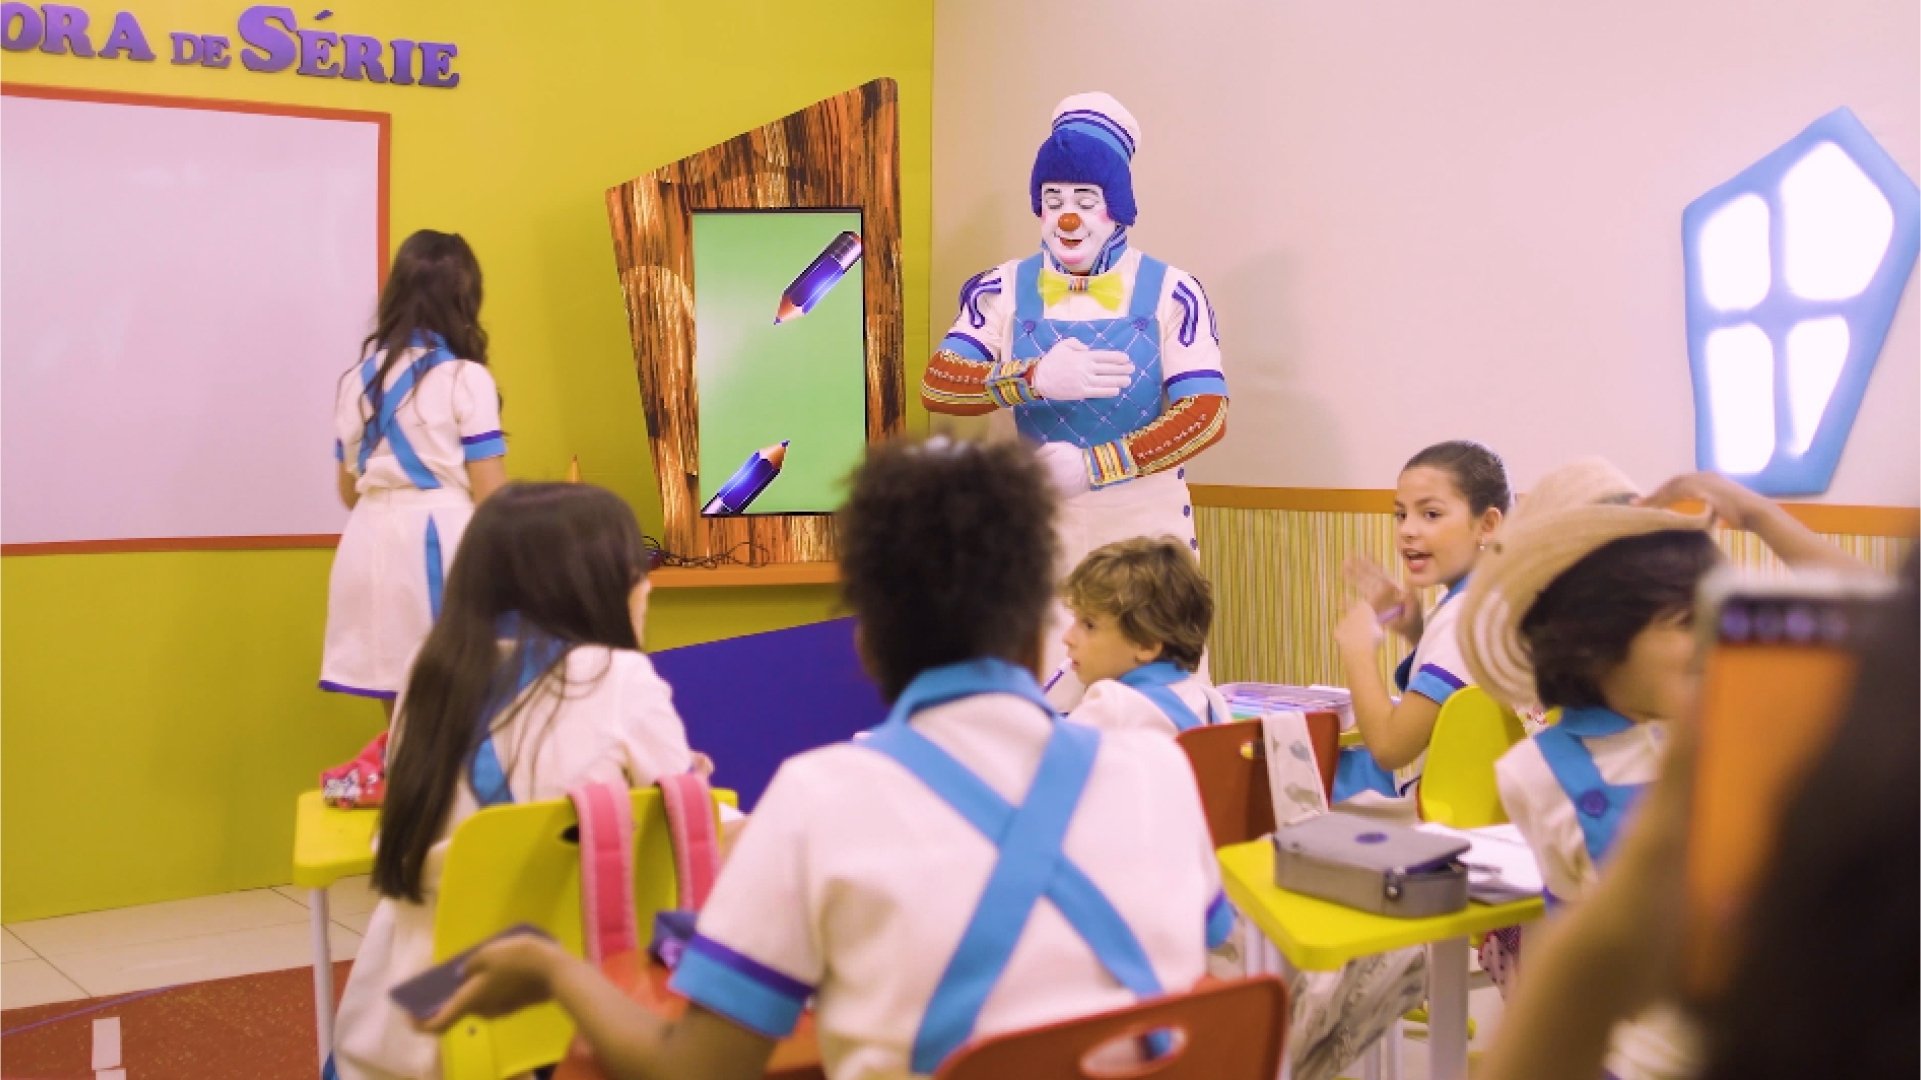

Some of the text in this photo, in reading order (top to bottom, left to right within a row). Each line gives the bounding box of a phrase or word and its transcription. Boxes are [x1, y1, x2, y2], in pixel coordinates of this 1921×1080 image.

[0, 2, 460, 88] ORA DE SÉRIE
